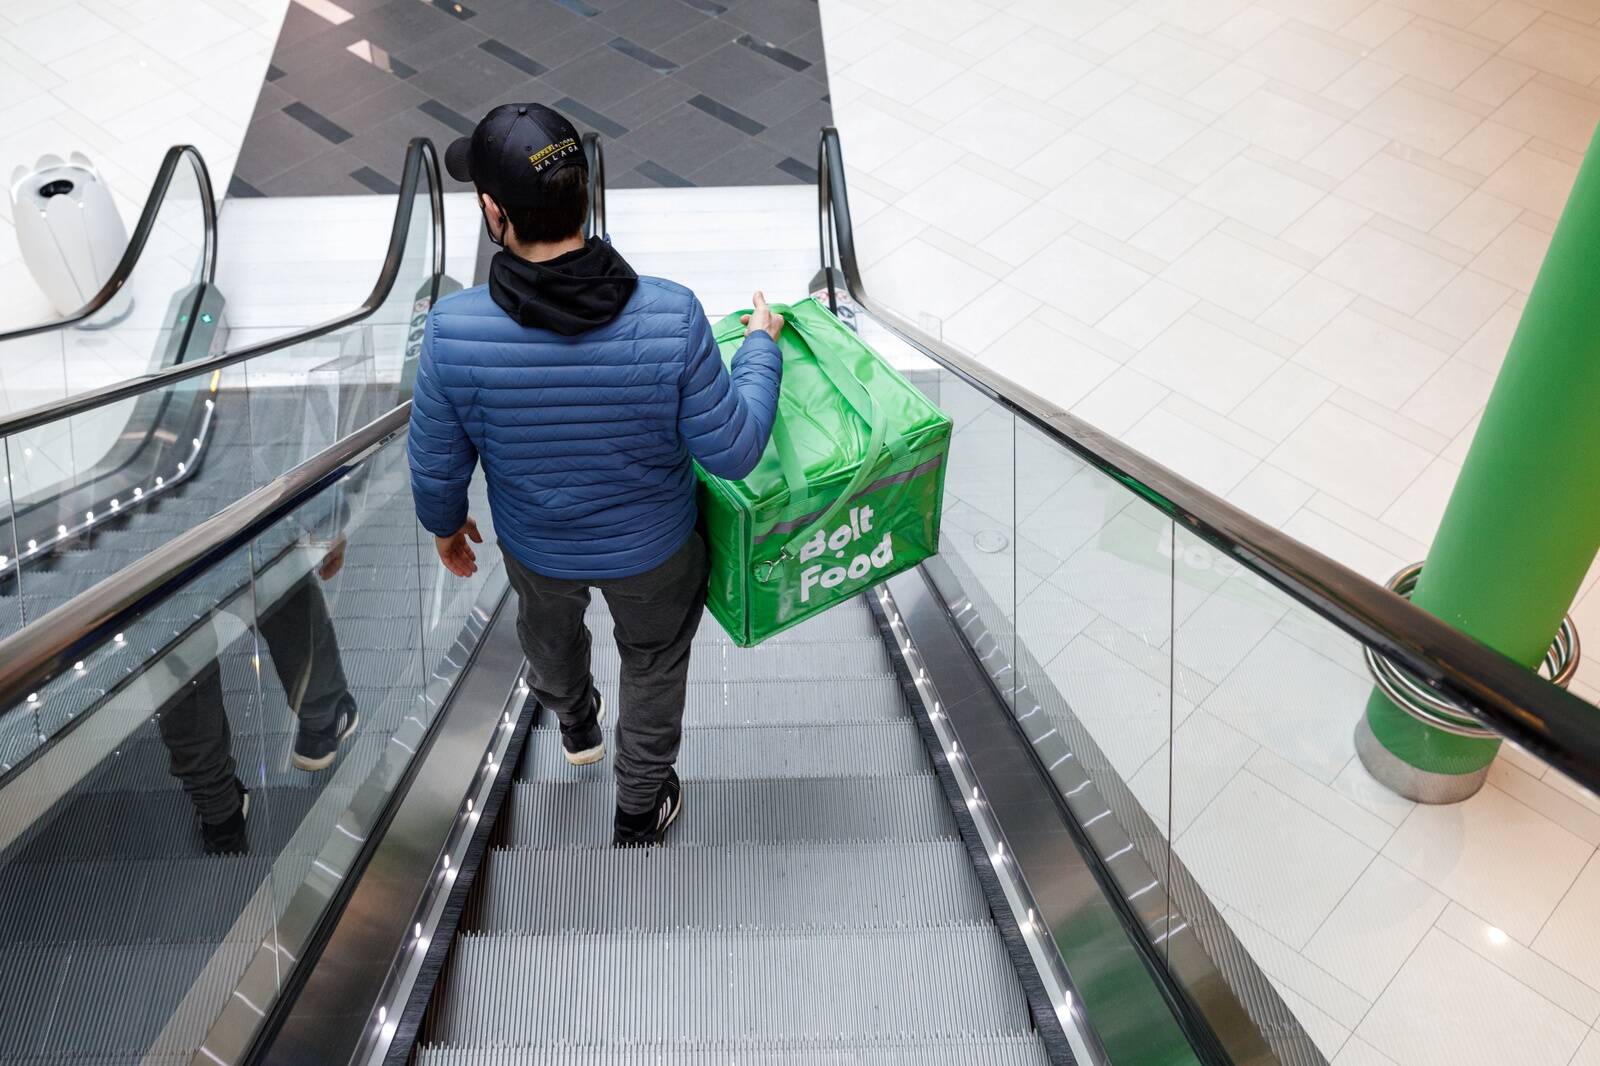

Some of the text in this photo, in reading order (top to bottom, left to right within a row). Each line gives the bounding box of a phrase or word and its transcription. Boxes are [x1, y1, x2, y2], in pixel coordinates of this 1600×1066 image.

[535, 145, 579, 173] MALAGA
[800, 505, 874, 563] Bolt
[800, 531, 894, 602] Food
